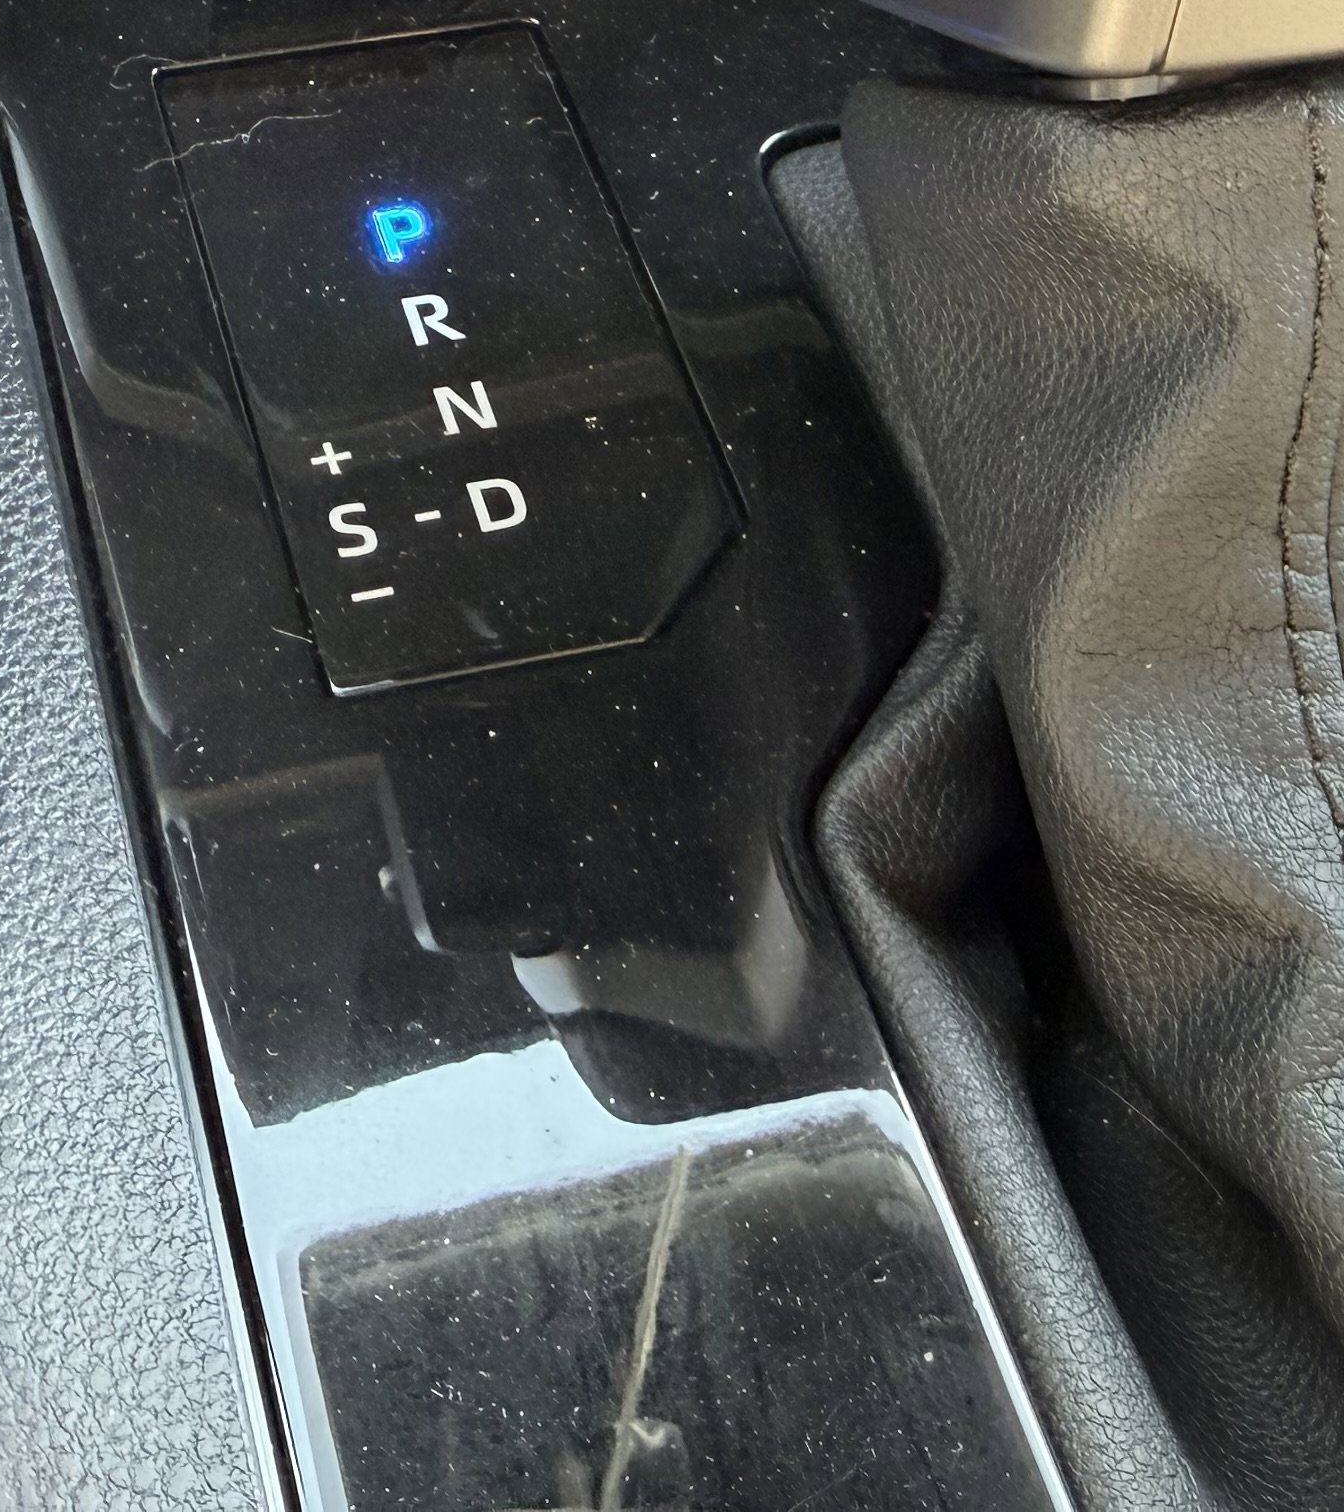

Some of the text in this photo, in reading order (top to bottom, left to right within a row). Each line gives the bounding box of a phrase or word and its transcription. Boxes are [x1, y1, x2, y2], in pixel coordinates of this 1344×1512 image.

[371, 205, 427, 264] P
[400, 294, 467, 347] R
[432, 380, 498, 436] N
[328, 502, 378, 558] S
[465, 478, 527, 533] D
